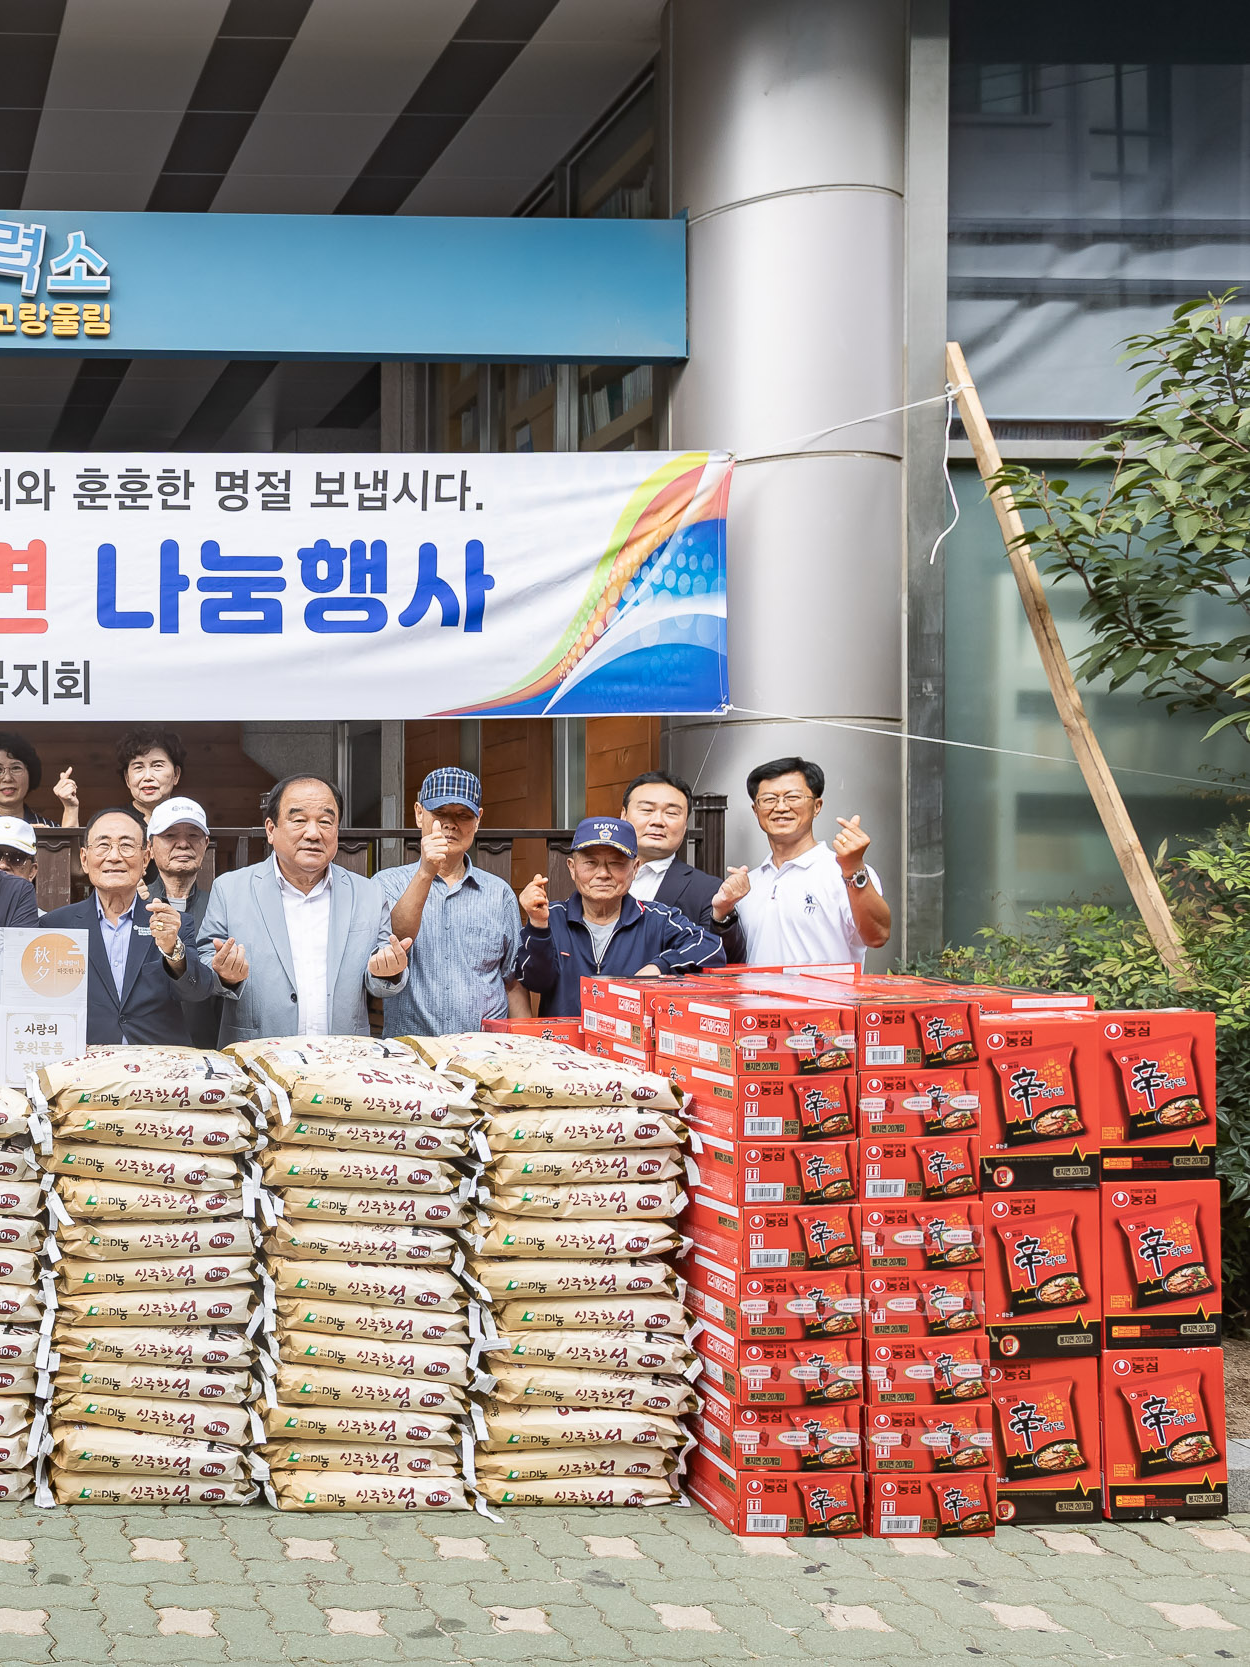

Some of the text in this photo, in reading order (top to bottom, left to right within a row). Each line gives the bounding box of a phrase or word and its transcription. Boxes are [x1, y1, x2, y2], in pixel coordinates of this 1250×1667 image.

[74, 469, 194, 510] 훈훈한
[216, 470, 290, 511] 명절
[311, 470, 482, 511] 보냅시다.
[97, 539, 495, 634] 나눔행사
[758, 1018, 780, 1028] 농심
[882, 1014, 904, 1024] 농심
[24, 1022, 58, 1035] 사랑의
[1124, 1026, 1150, 1037] 농심
[1006, 1036, 1032, 1047] 농심
[14, 1040, 65, 1055] 후원물품
[761, 1085, 783, 1095] 농심
[1131, 1193, 1157, 1205] 농심
[1010, 1203, 1035, 1215] 농심
[1132, 1362, 1158, 1373] 농심
[1004, 1369, 1031, 1380] 농심
[758, 1412, 782, 1423] 농심
[763, 1483, 787, 1493] 농심
